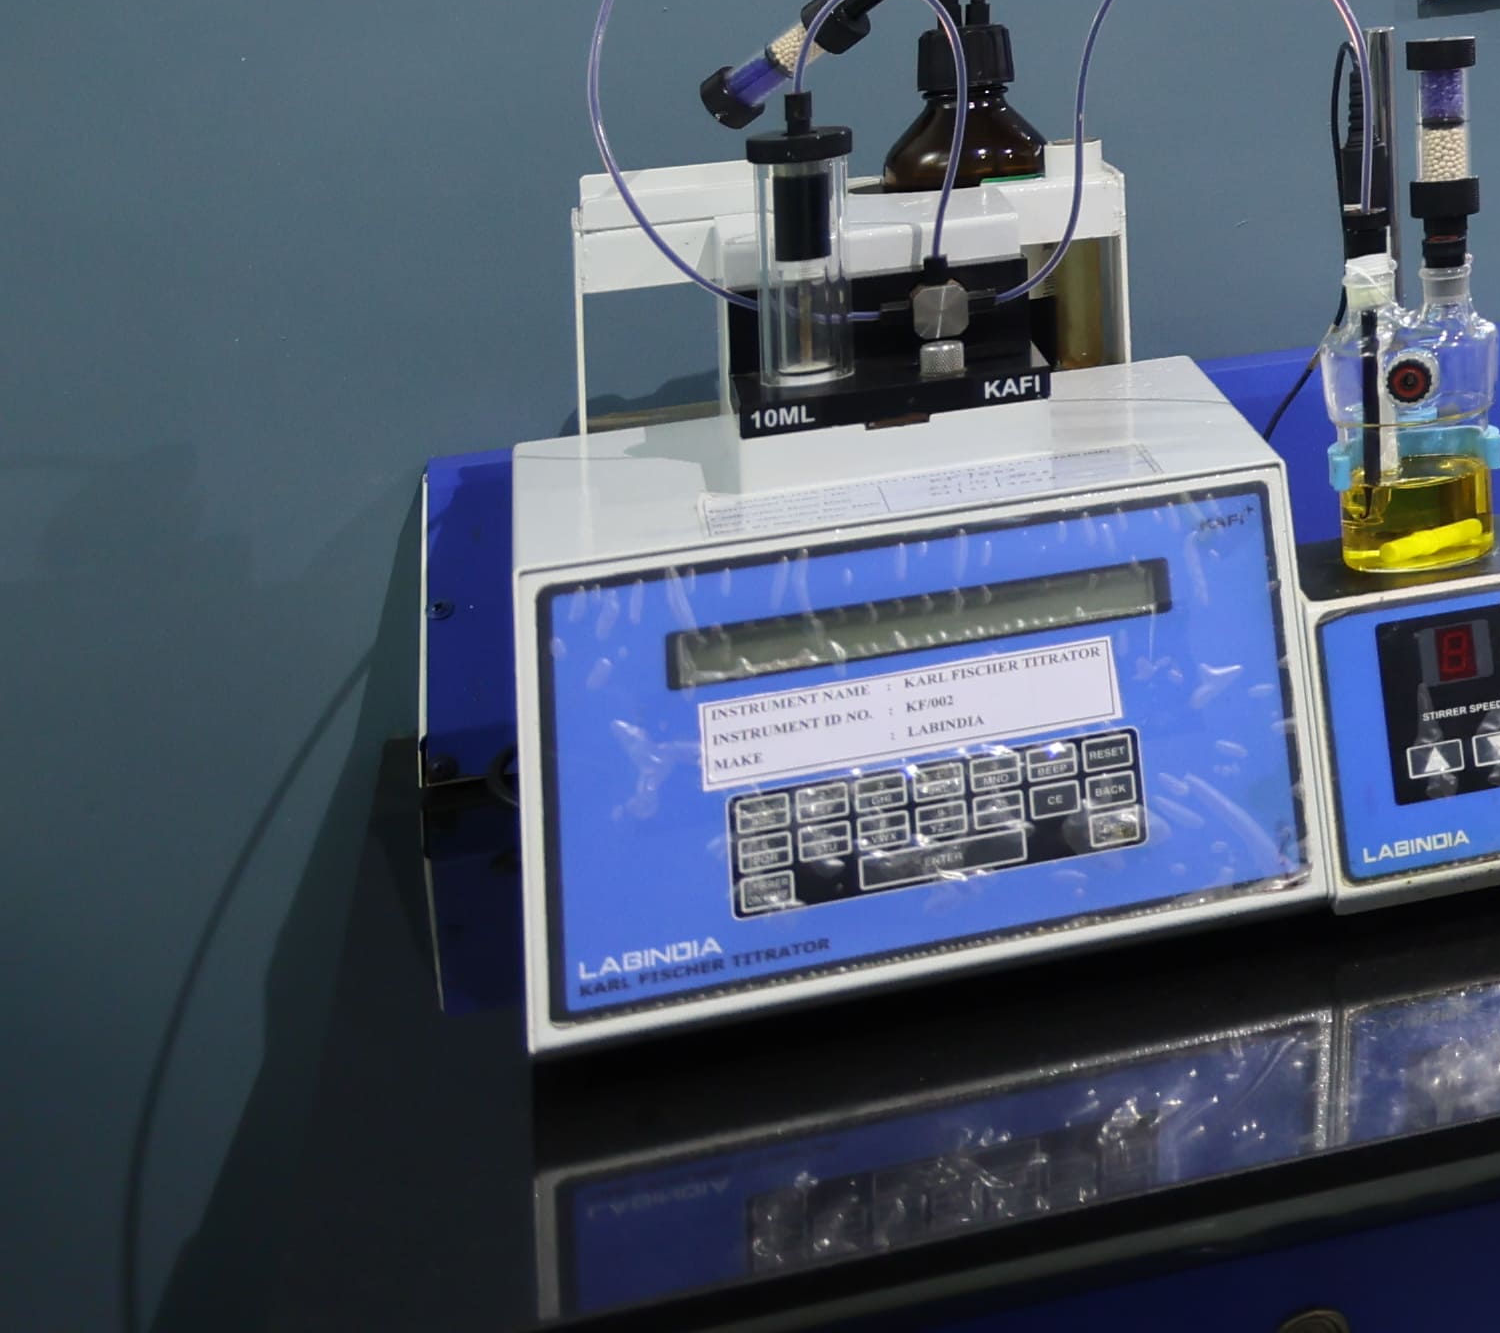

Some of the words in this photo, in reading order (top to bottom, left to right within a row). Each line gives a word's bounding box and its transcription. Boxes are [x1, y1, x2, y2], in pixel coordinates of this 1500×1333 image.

[983, 373, 1042, 401] KAFI
[749, 403, 816, 431] 10ML
[711, 691, 819, 721] INSTRUMENT
[822, 684, 871, 703] NAME
[903, 671, 950, 689] KARL
[951, 658, 1020, 682] FISCHER
[1023, 645, 1102, 670] TITRATOR
[712, 717, 821, 747] INSTRUMENT
[825, 713, 843, 727] ID
[847, 710, 874, 724] NO.
[905, 695, 955, 715] KF/002
[1422, 706, 1468, 722] STIRRER
[713, 751, 765, 773] MAKE
[907, 715, 985, 739] LABINDIA
[1088, 745, 1126, 761] RESET
[1037, 763, 1068, 777] BEEP
[1047, 793, 1063, 806] CE
[1095, 783, 1128, 798] BACK
[923, 851, 964, 868] ENTER
[1362, 829, 1470, 864] LABINDIA
[578, 936, 723, 981] LABINDIA
[579, 974, 631, 998] KARL
[638, 957, 725, 985] FISCHER
[733, 937, 831, 969] TITRATOR
